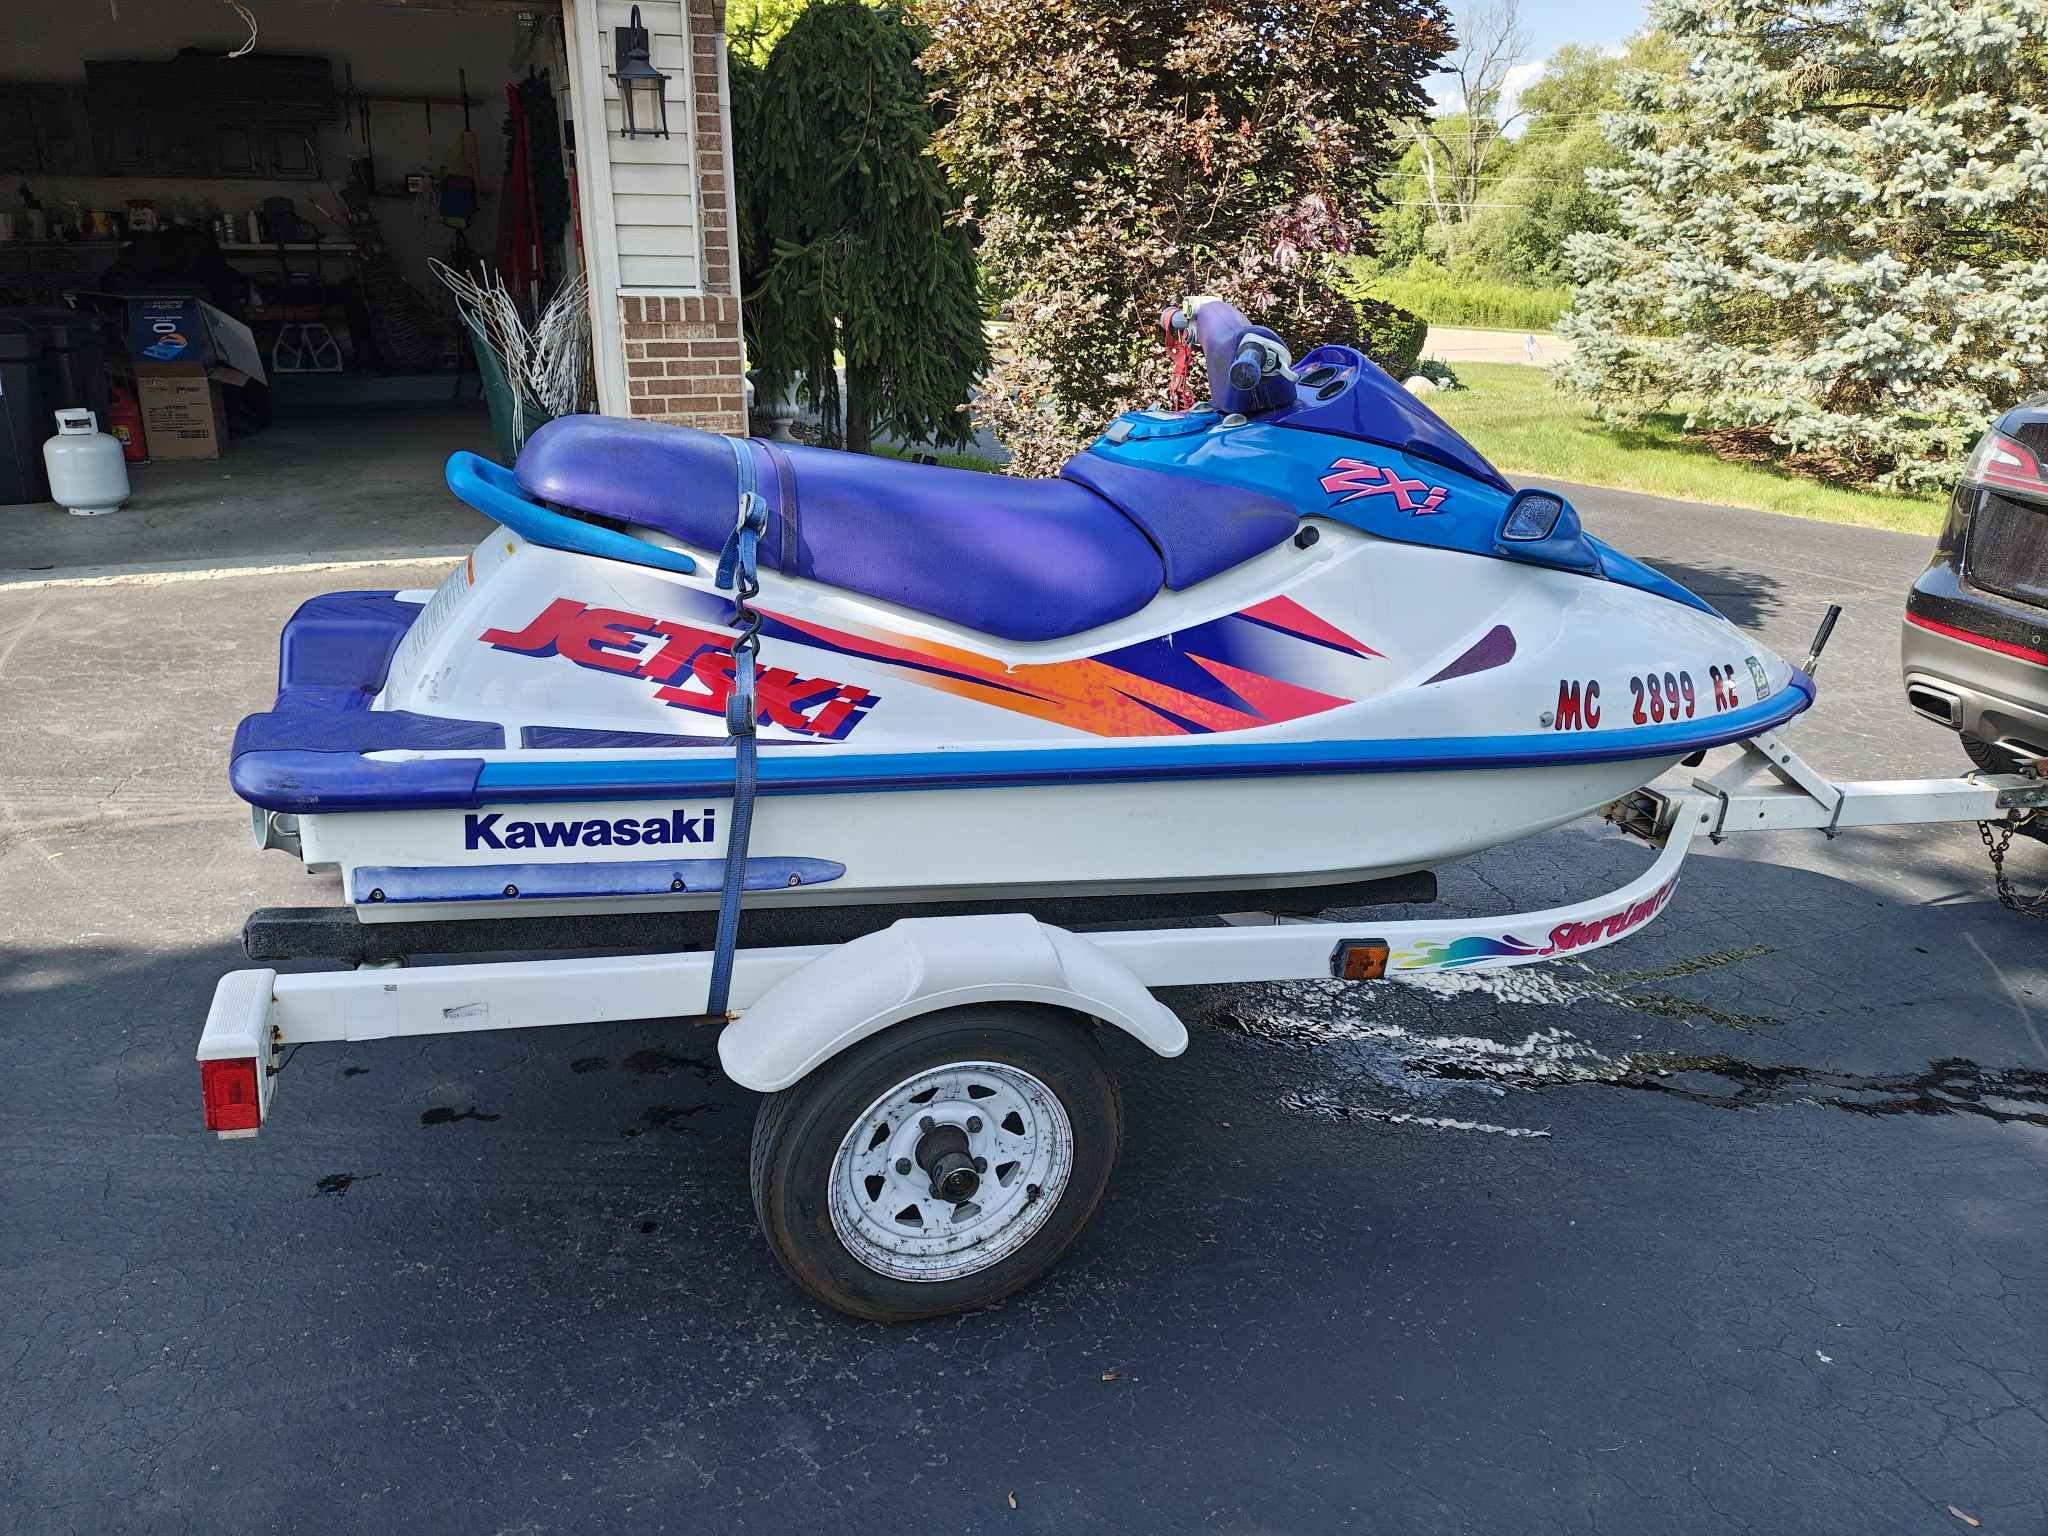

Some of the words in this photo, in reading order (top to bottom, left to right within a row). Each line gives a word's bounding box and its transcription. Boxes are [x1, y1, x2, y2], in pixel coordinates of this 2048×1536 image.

[1555, 680, 1600, 731] MC
[1630, 670, 1695, 725] 2899
[464, 809, 715, 849] Kawasaki
